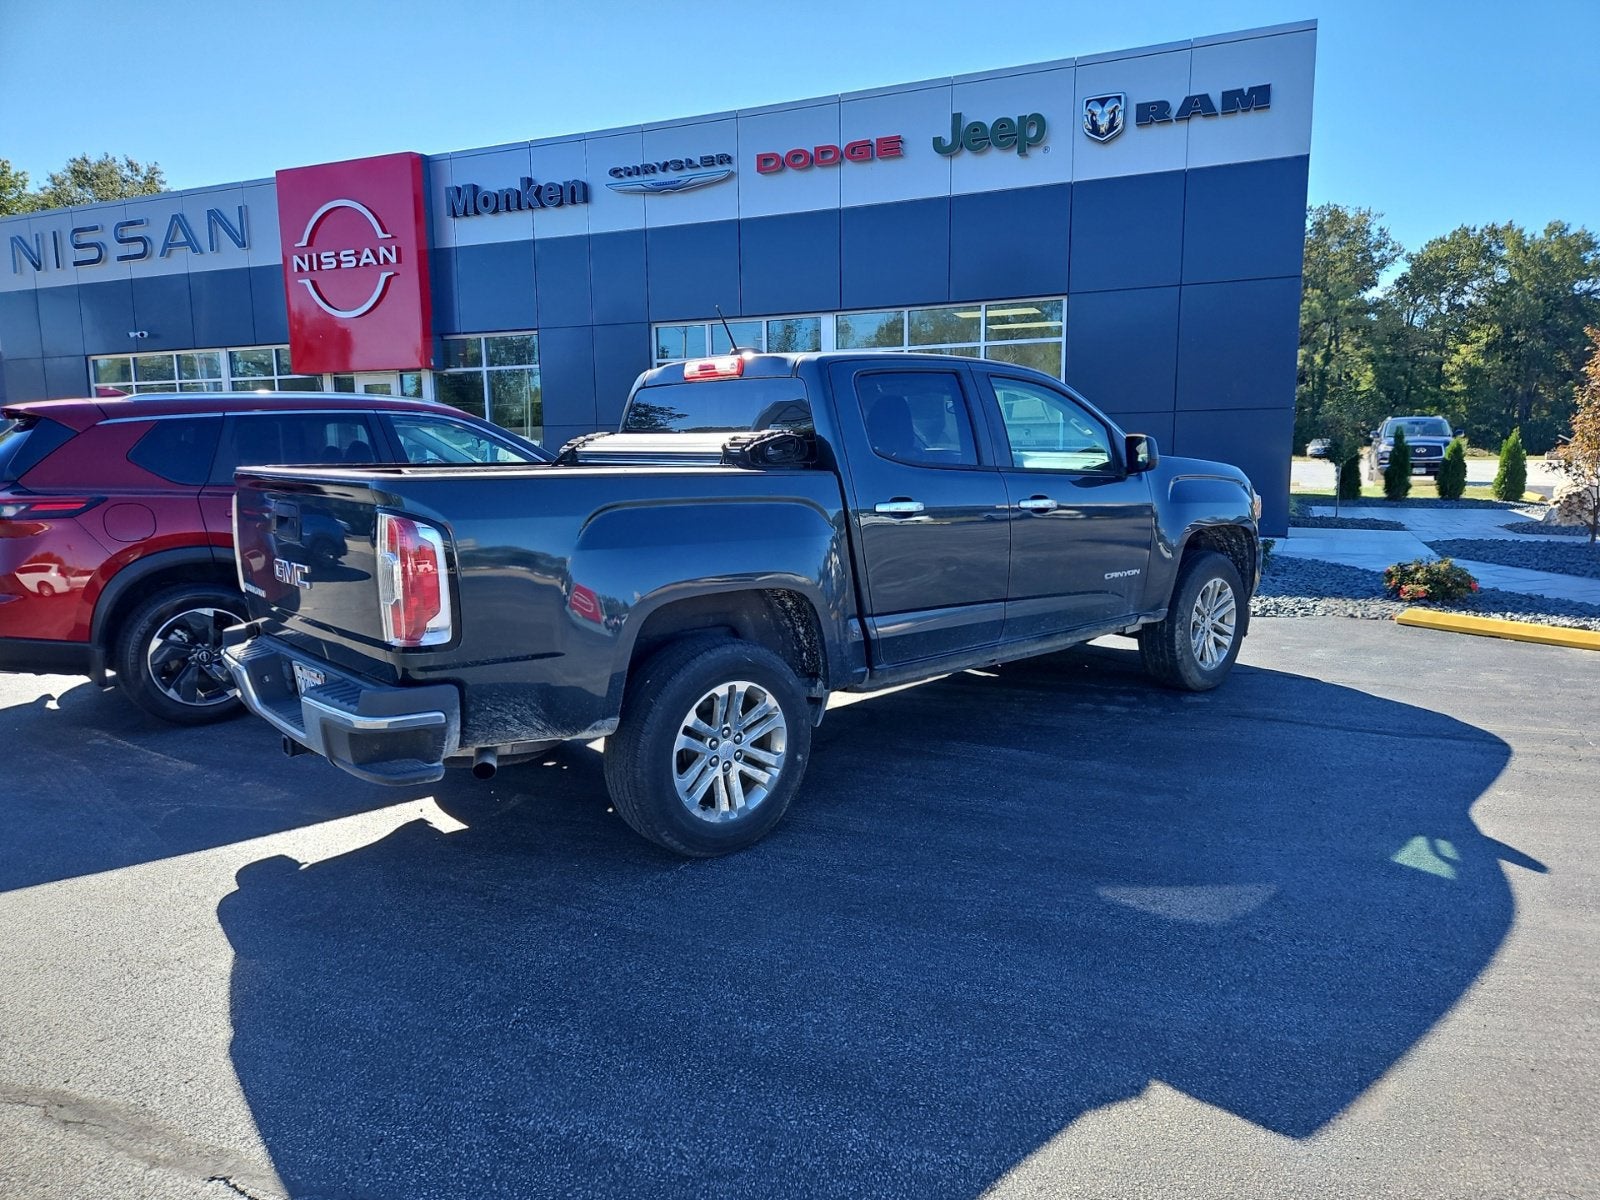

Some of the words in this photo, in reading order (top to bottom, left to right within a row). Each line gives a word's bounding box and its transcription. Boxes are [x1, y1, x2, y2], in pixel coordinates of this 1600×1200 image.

[1135, 83, 1271, 128] RAM
[932, 111, 1047, 157] Jeep
[608, 153, 733, 179] CHRYSLER
[756, 135, 905, 175] DODGE
[445, 177, 589, 218] Monken
[10, 204, 248, 275] NISSAN
[292, 245, 399, 273] NISSAN
[273, 558, 312, 590] GMC
[1104, 568, 1141, 580] CANYON
